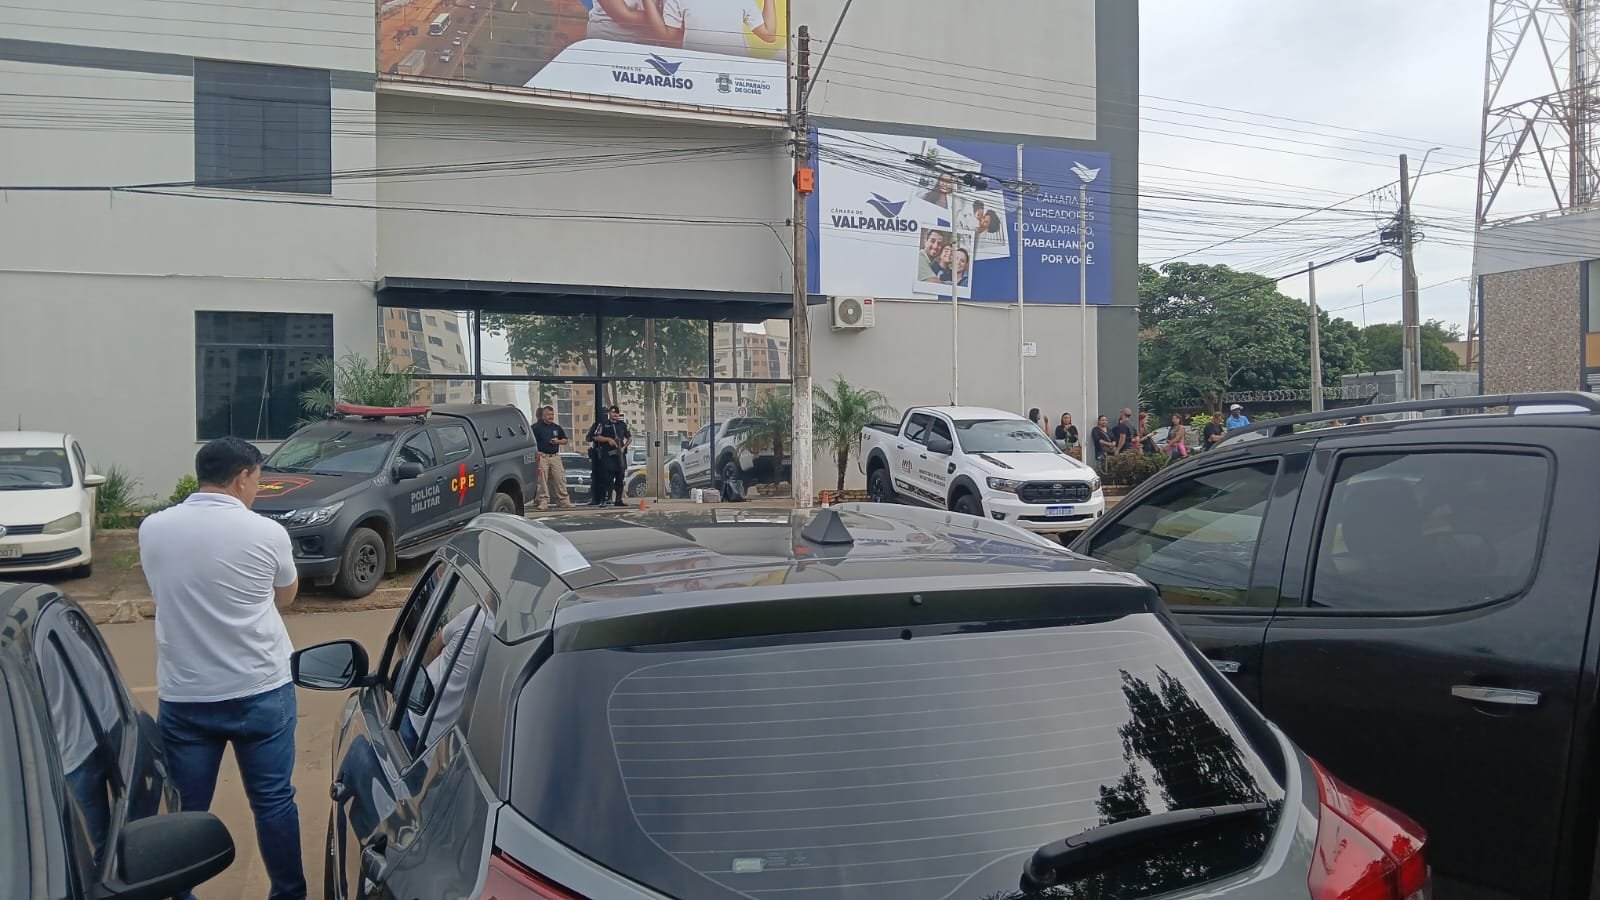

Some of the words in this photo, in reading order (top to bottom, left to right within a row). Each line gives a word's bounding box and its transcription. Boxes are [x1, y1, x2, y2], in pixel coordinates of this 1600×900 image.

[612, 71, 693, 89] VALPARAÍSO
[1036, 192, 1079, 205] CÂMARA
[831, 215, 918, 232] VALPARAÍSO
[1031, 223, 1095, 237] VALPARAÍO,
[1021, 238, 1095, 250] RABALHANO
[1041, 254, 1062, 265] POR
[1064, 254, 1095, 265] VOÊ.
[451, 474, 475, 492] CPE
[411, 485, 441, 502] POLÍCIA
[411, 495, 441, 514] MILITAR
